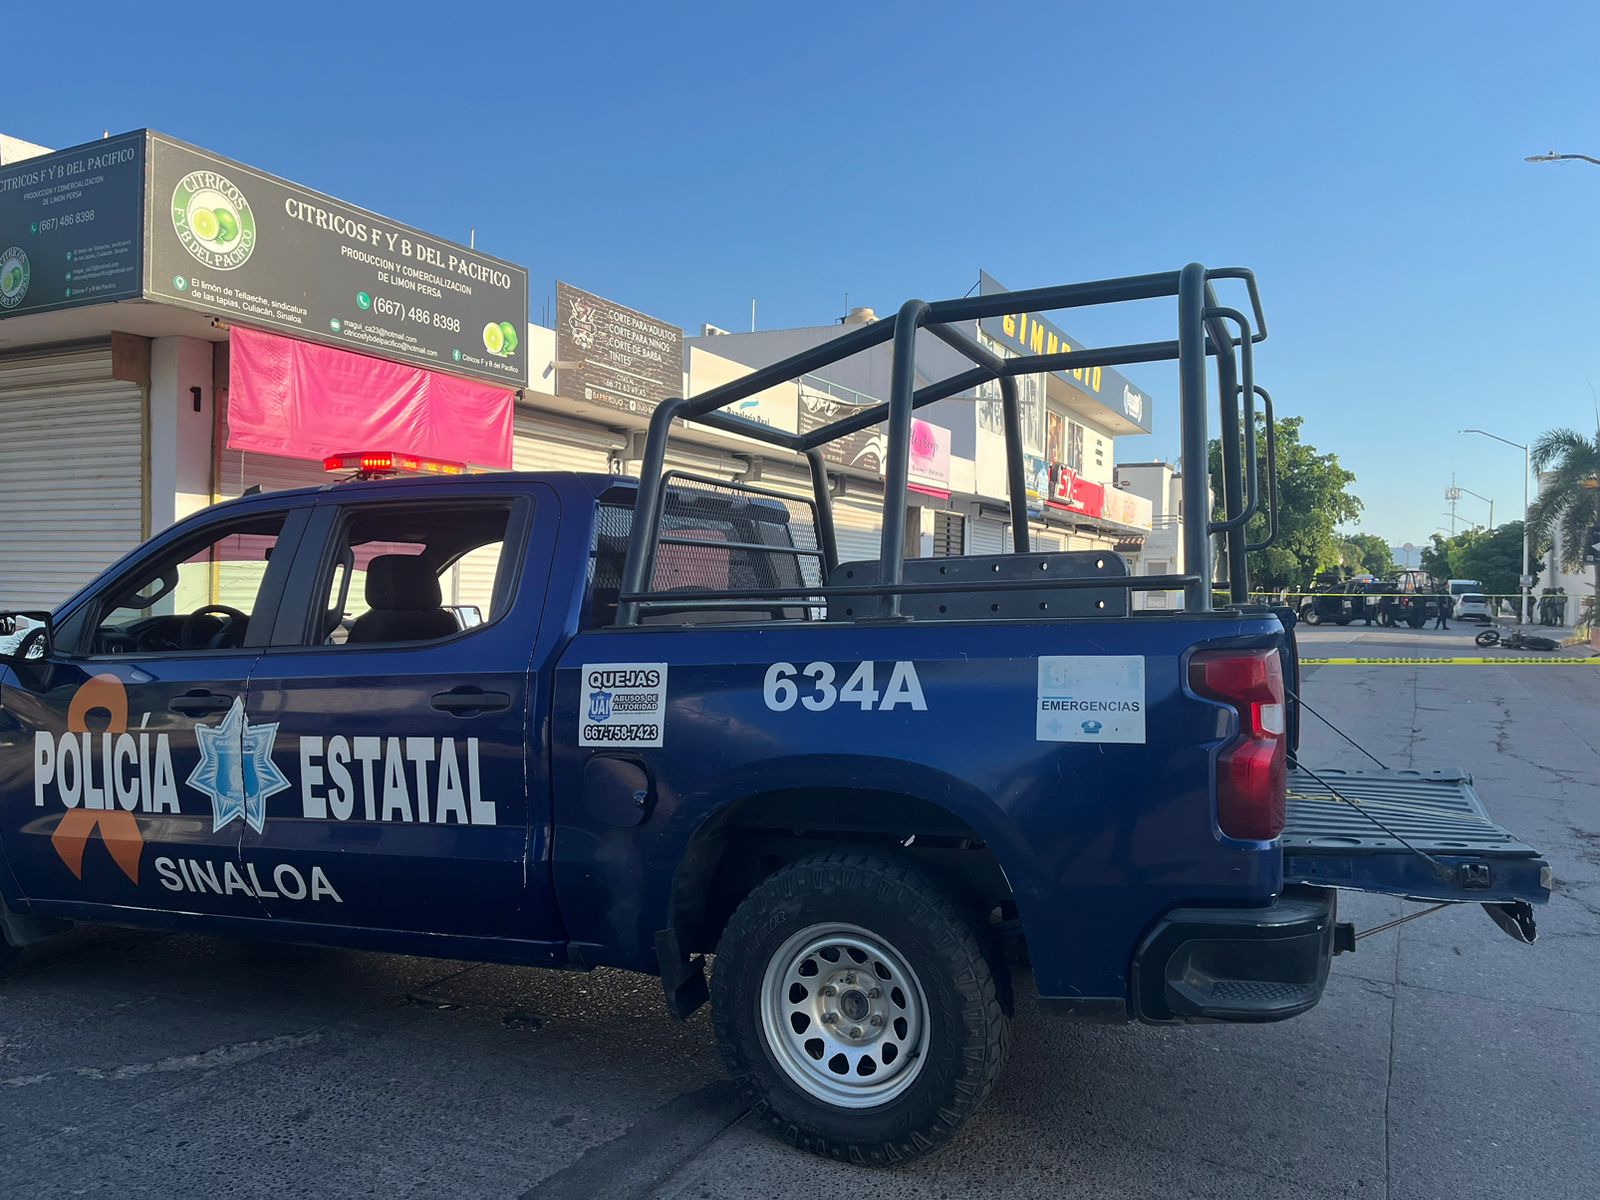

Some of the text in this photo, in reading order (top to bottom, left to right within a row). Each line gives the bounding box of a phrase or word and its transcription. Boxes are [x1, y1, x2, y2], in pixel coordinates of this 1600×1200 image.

[40, 170, 47, 183] F
[48, 165, 57, 180] Y
[57, 166, 64, 179] B
[67, 161, 86, 176] DEL
[88, 147, 135, 171] PACIFICO
[183, 173, 247, 210] CITRICOS
[39, 209, 95, 234] (667) 486 8398
[180, 230, 192, 243] B
[189, 241, 213, 264] DEL
[214, 229, 253, 267] PACIFICO
[285, 197, 511, 290] CITRICOS F Y B DEL PACIFICO
[341, 245, 472, 296] PRODUCCION Y COMERCIALIZACION
[191, 289, 202, 298] de
[203, 291, 215, 302] las
[223, 287, 233, 296] de
[377, 271, 442, 299] DE LIMON PERSA
[373, 296, 460, 333] (667) 486 8398
[608, 309, 631, 326] CORTE
[632, 318, 649, 332] PARA
[648, 325, 677, 343] ADULTOS
[608, 323, 631, 340] CORTE
[632, 332, 649, 345] PARA
[608, 337, 632, 353] CORTE
[632, 345, 642, 356] DE
[588, 670, 661, 690] QUEJAS
[763, 660, 928, 713] 634A
[591, 699, 609, 715] UAI
[612, 702, 659, 712] AUTORIDAD
[613, 693, 646, 703] ABUSOS
[646, 693, 659, 703] DE
[1041, 700, 1140, 712] EMERGENCIAS
[584, 723, 659, 741] 667-758-7423
[34, 712, 497, 826] POLICÍA ESTATAL
[154, 856, 343, 903] SINALOA
